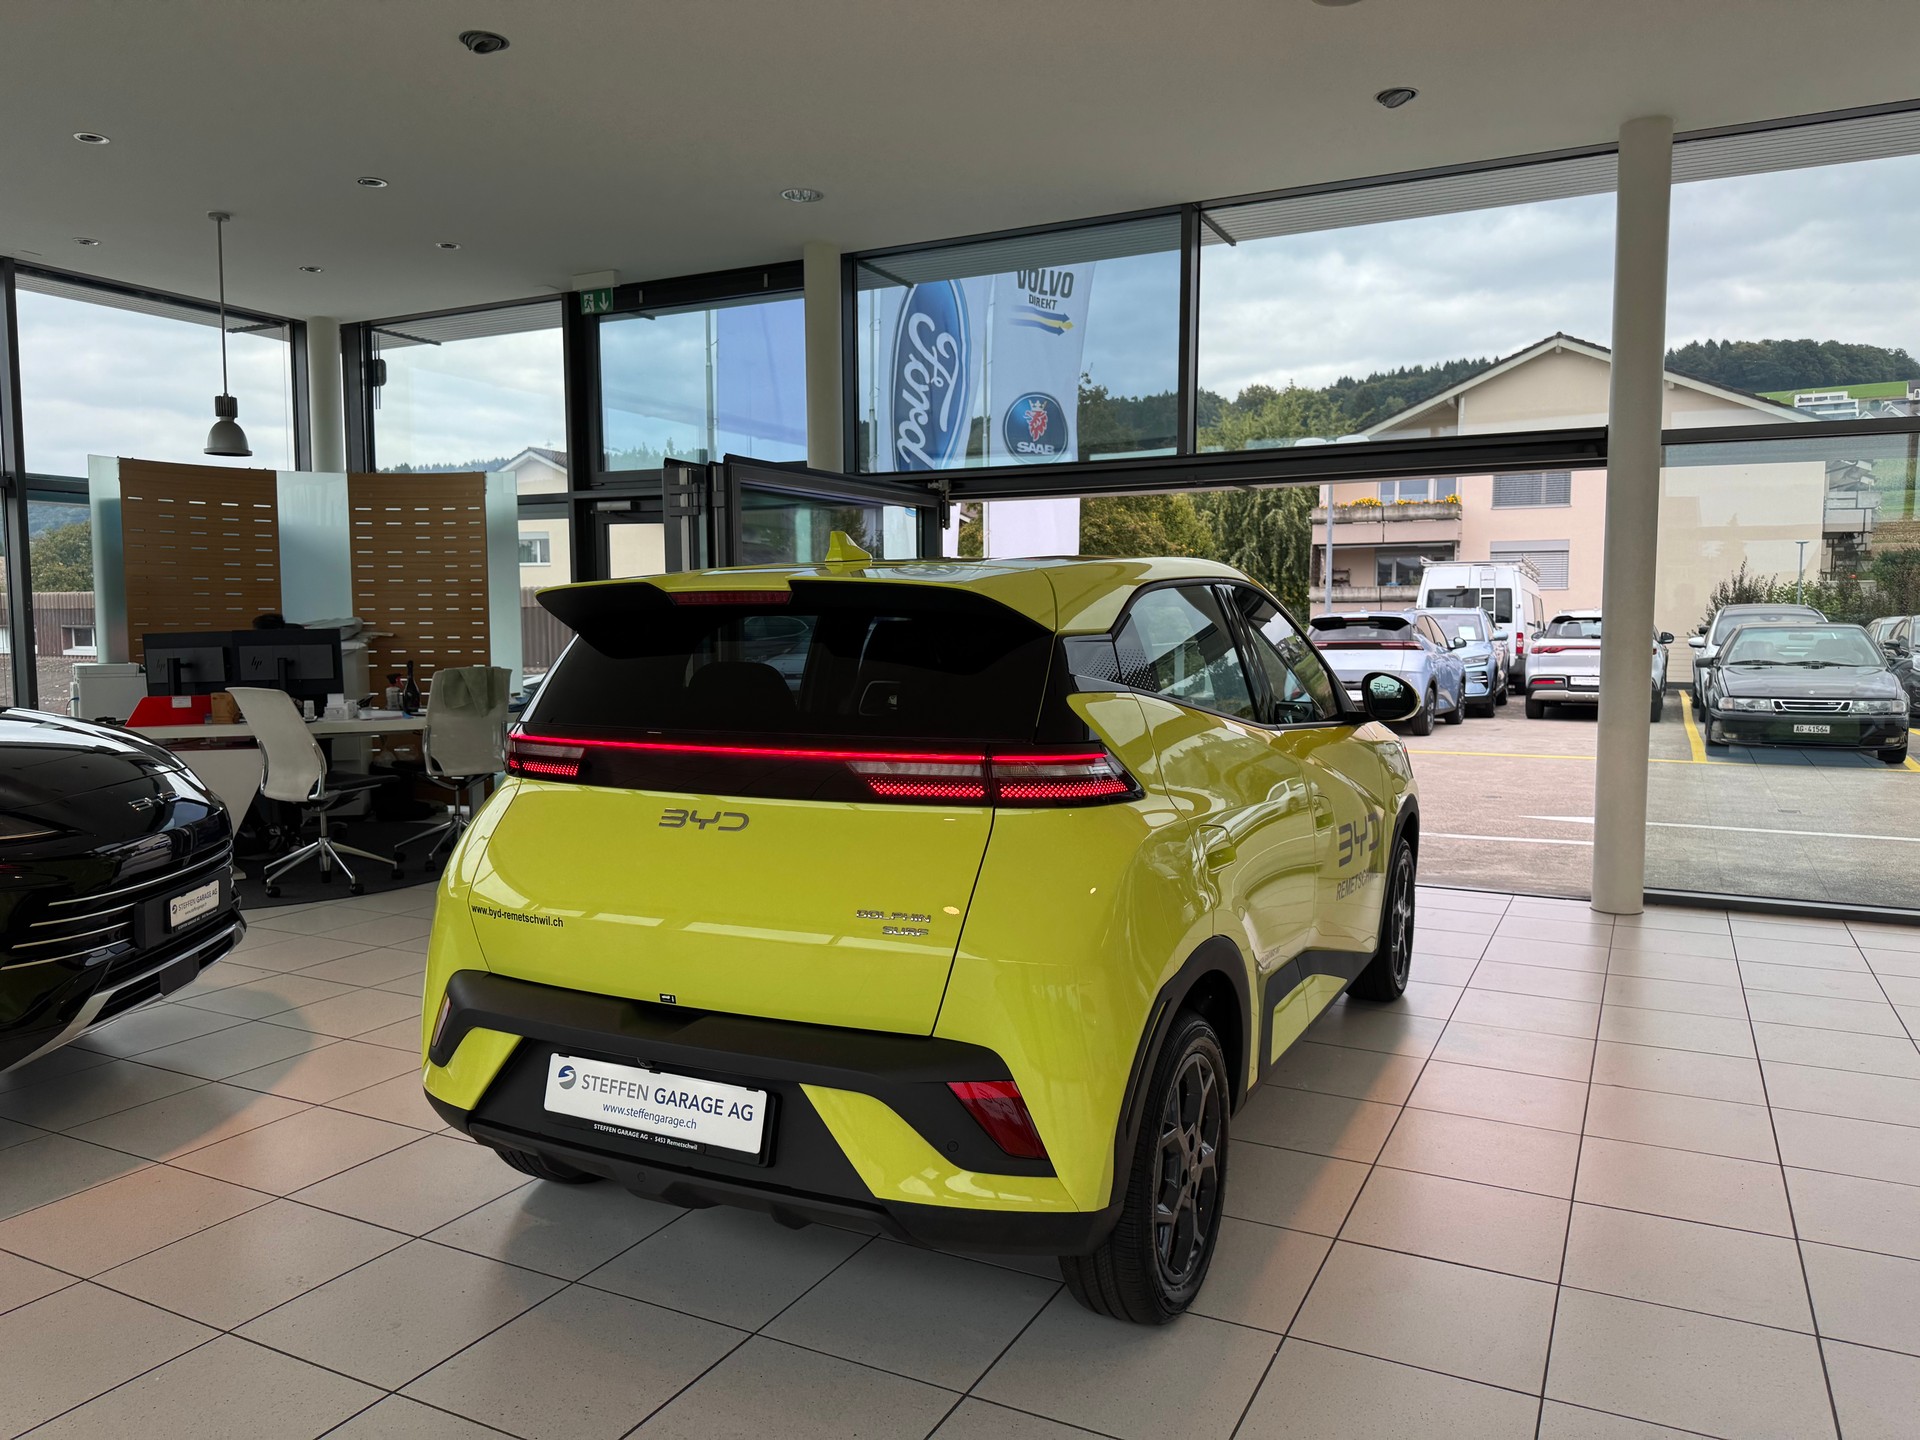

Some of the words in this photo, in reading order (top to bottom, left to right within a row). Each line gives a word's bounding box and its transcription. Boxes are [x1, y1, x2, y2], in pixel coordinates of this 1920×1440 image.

[1017, 268, 1074, 299] VOLVO
[1028, 294, 1058, 311] DIREKT
[897, 312, 959, 470] Ford
[1016, 441, 1055, 455] SAAB
[251, 656, 263, 672] hp
[658, 808, 750, 832] BYD
[1338, 812, 1380, 868] BYD
[178, 898, 196, 912] STEFFEN
[471, 904, 564, 928] www.byd-remetschwil.ch
[856, 909, 931, 923] DOLPHIN
[882, 925, 929, 937] SURF
[581, 1074, 649, 1101] STEFFEN
[654, 1087, 724, 1116] GARAGE
[727, 1102, 754, 1122] AG
[602, 1103, 697, 1130] www.steffengarage.ch
[593, 1123, 617, 1134] STEFFEN
[617, 1128, 640, 1138] GARAGE
[654, 1136, 667, 1144] 5453
[666, 1139, 698, 1150] Remetschwil
